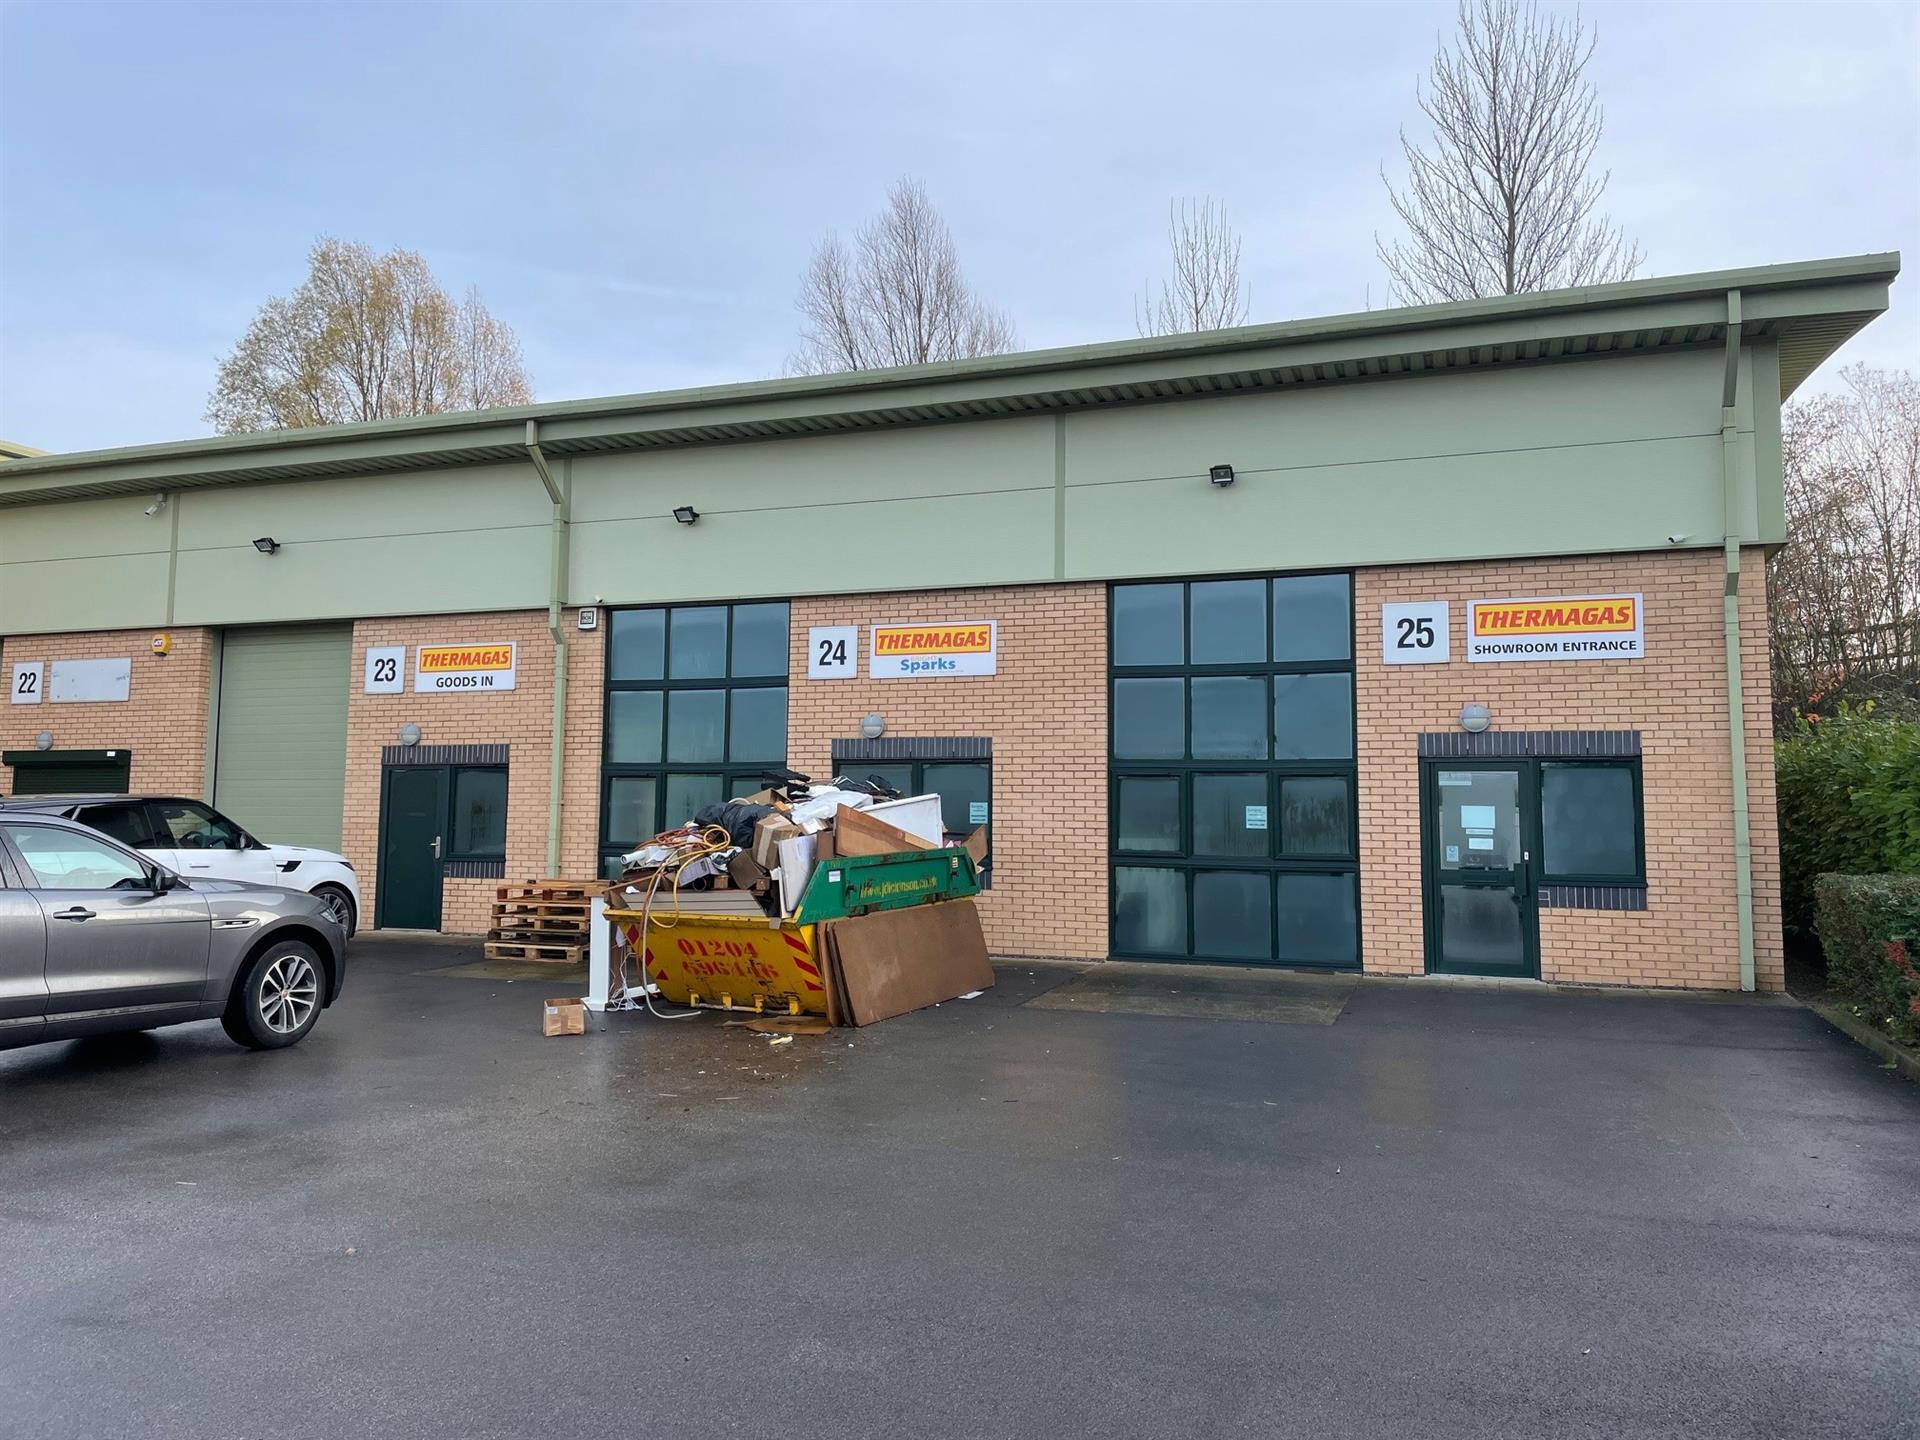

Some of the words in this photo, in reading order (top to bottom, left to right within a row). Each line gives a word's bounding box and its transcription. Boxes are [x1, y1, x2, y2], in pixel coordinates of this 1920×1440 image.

[1478, 606, 1631, 629] THERMAGAS
[878, 631, 988, 650] THERMAGAS
[1396, 617, 1435, 649] 25
[818, 639, 847, 666] 24
[1474, 642, 1558, 655] SHOWROOM
[1562, 640, 1637, 652] ENTRANCE
[422, 650, 510, 667] THERMAGAS
[900, 657, 956, 674] Sparks
[374, 658, 396, 682] 23
[18, 672, 37, 694] 22
[436, 676, 477, 688] GOODS
[481, 675, 494, 686] IN
[677, 938, 759, 958] 01204
